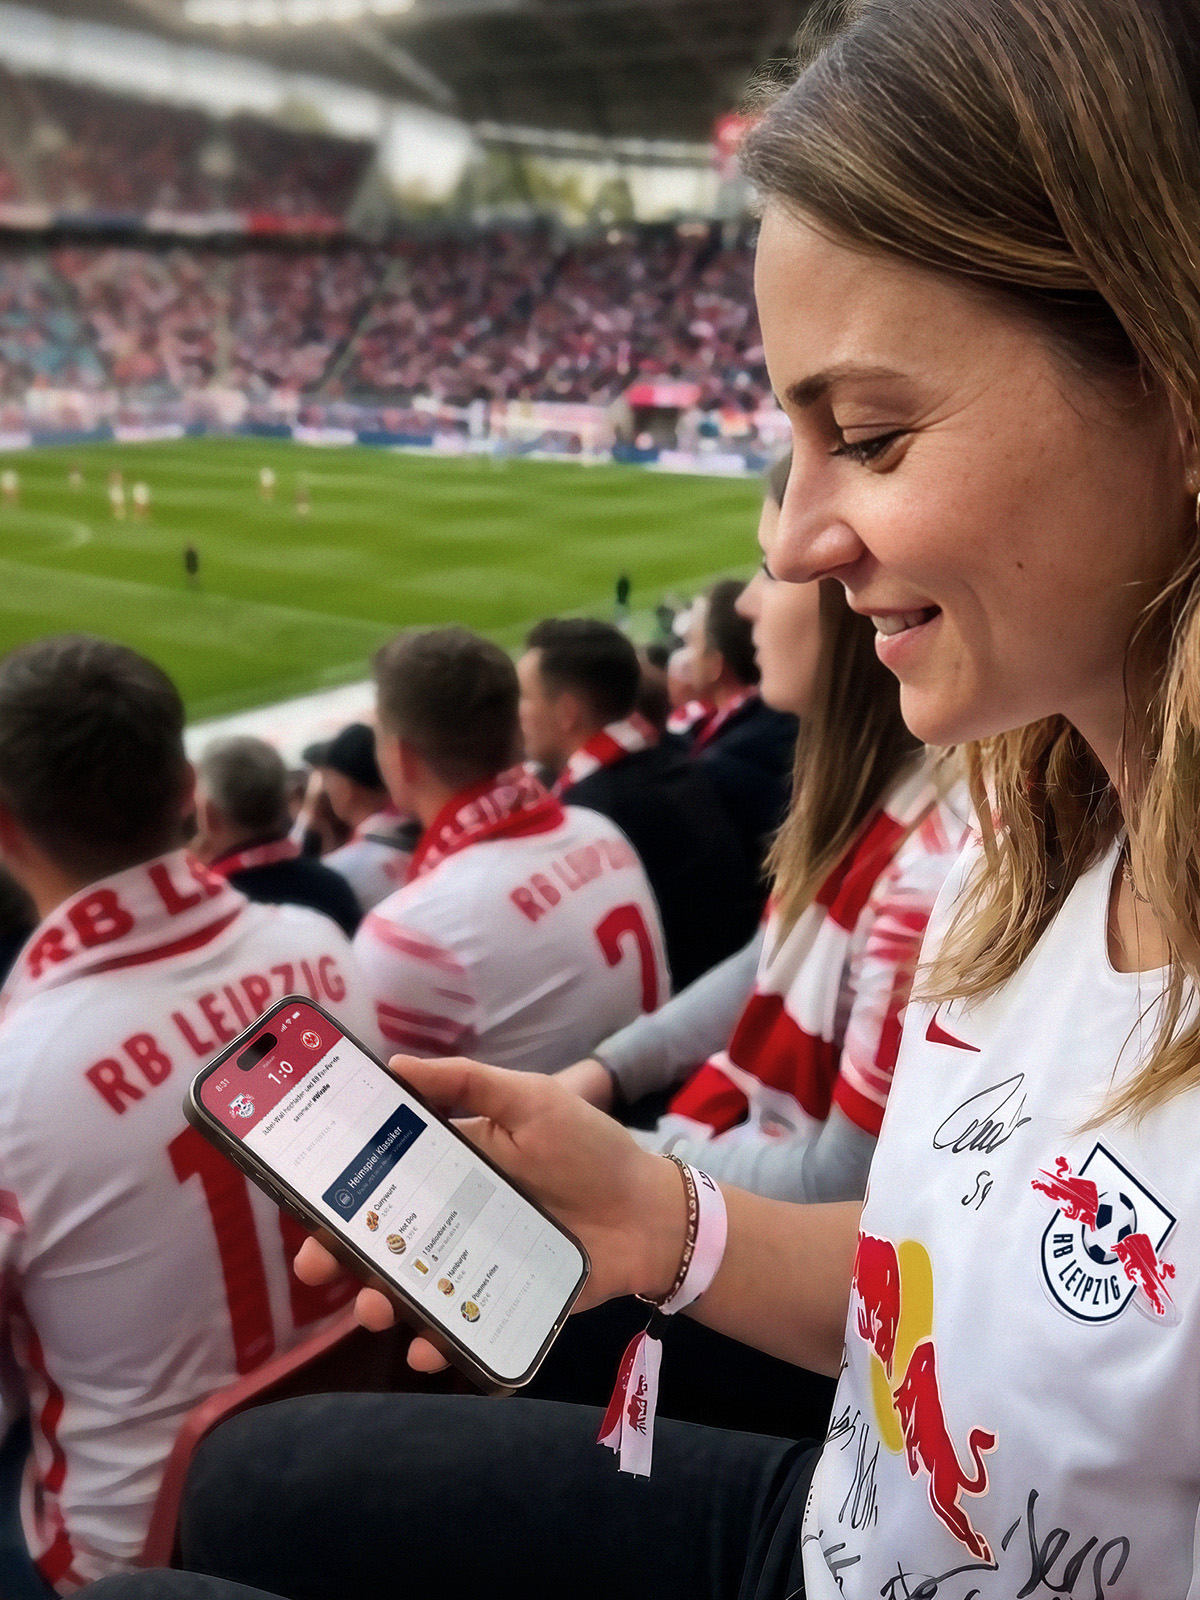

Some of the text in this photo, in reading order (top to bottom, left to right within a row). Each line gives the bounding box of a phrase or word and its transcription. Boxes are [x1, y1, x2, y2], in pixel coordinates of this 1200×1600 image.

[26, 888, 135, 980] RB
[593, 903, 660, 1015] 7
[85, 1033, 173, 1115] RB
[214, 1077, 229, 1092] 8:31
[266, 1058, 295, 1087] 1:0
[346, 1151, 381, 1190] Heimspiel
[374, 1124, 403, 1155] Klassiker
[373, 1183, 398, 1212] Currywurst
[397, 1211, 417, 1234] Hot Dog
[423, 1223, 449, 1252] Stadionbier
[443, 1209, 458, 1225] gratis
[445, 1248, 471, 1278] Hamburger
[470, 1263, 499, 1300] Pommes Frites
[1053, 1233, 1122, 1305] RB LEIPZIG
